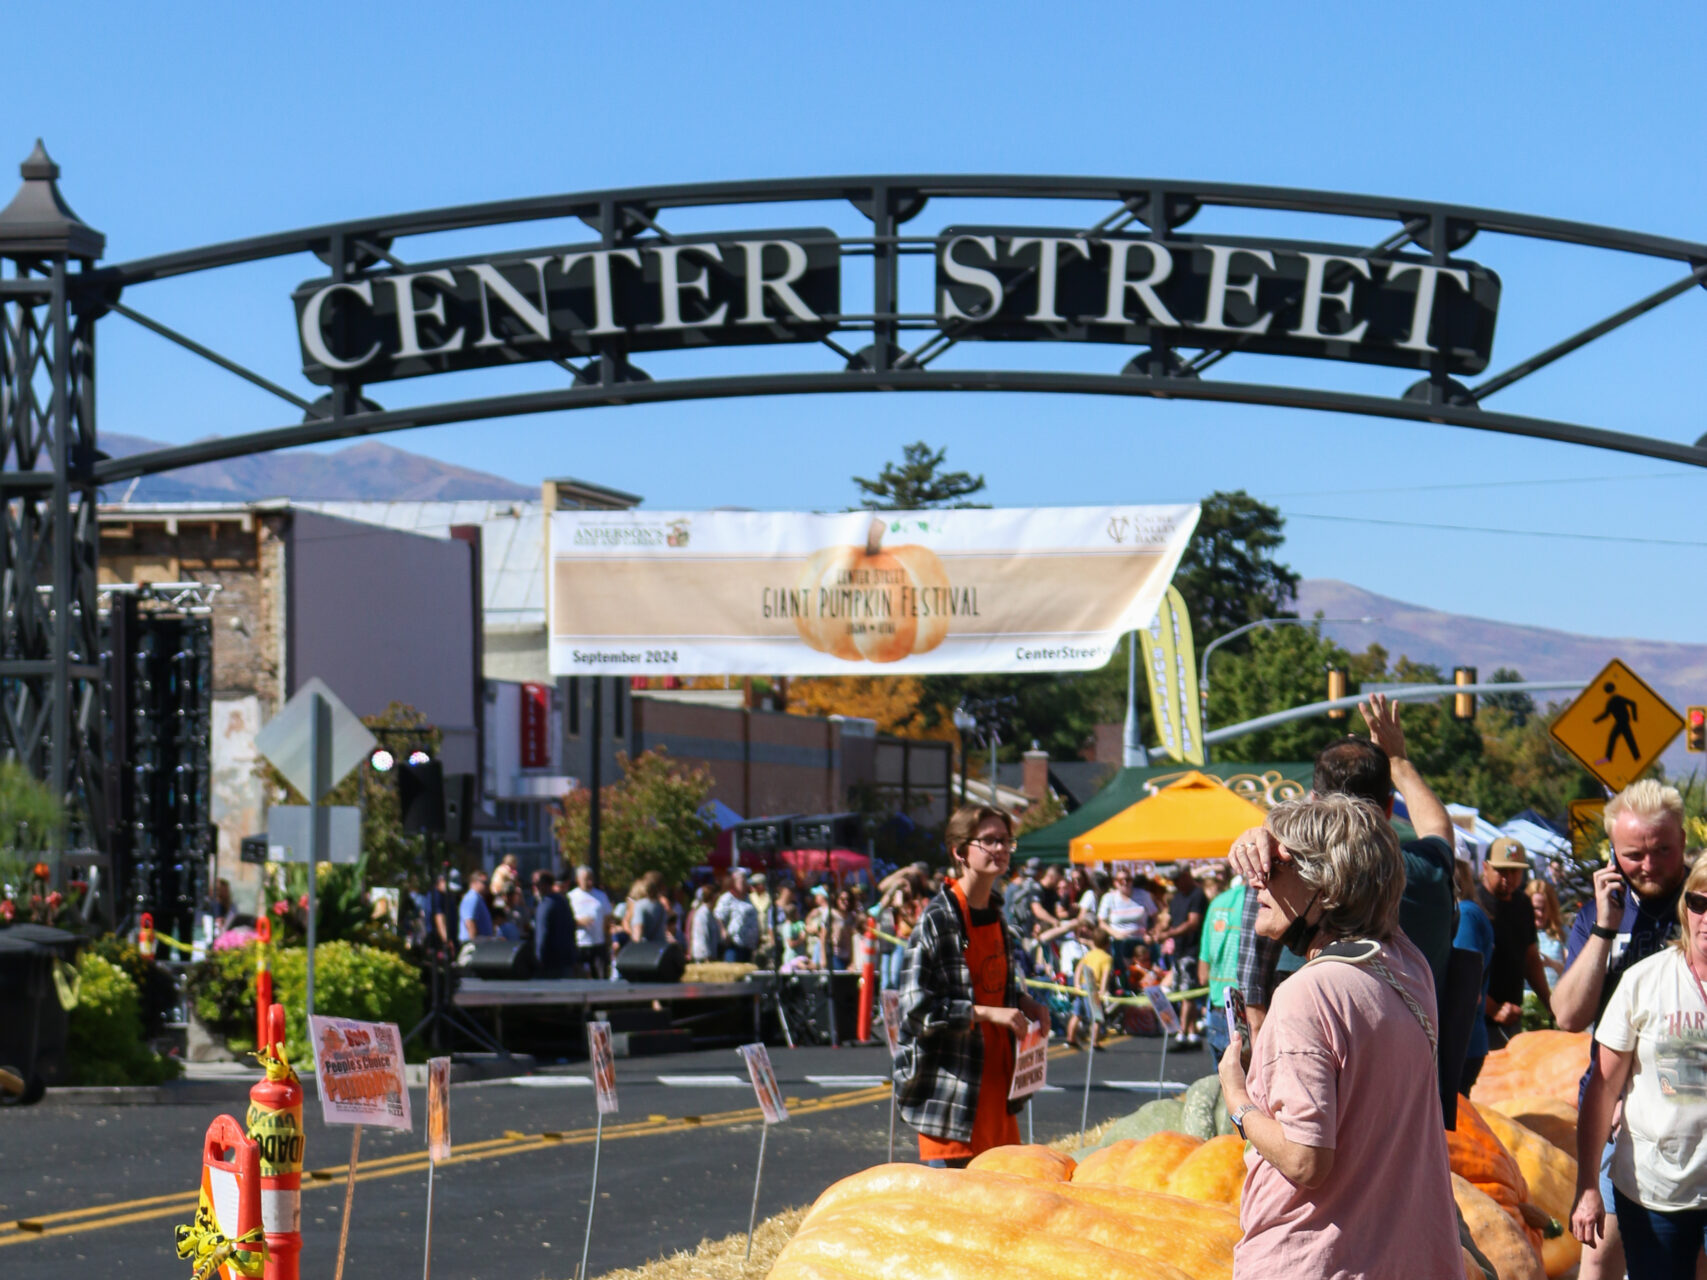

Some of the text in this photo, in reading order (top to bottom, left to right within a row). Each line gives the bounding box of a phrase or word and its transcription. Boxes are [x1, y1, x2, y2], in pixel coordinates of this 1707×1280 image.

[302, 235, 1471, 370] CENTER STREET
[762, 586, 980, 618] GIANT PUMPKIN FESTIVAL
[573, 650, 678, 664] September 2024
[325, 1055, 391, 1074] People's Choice
